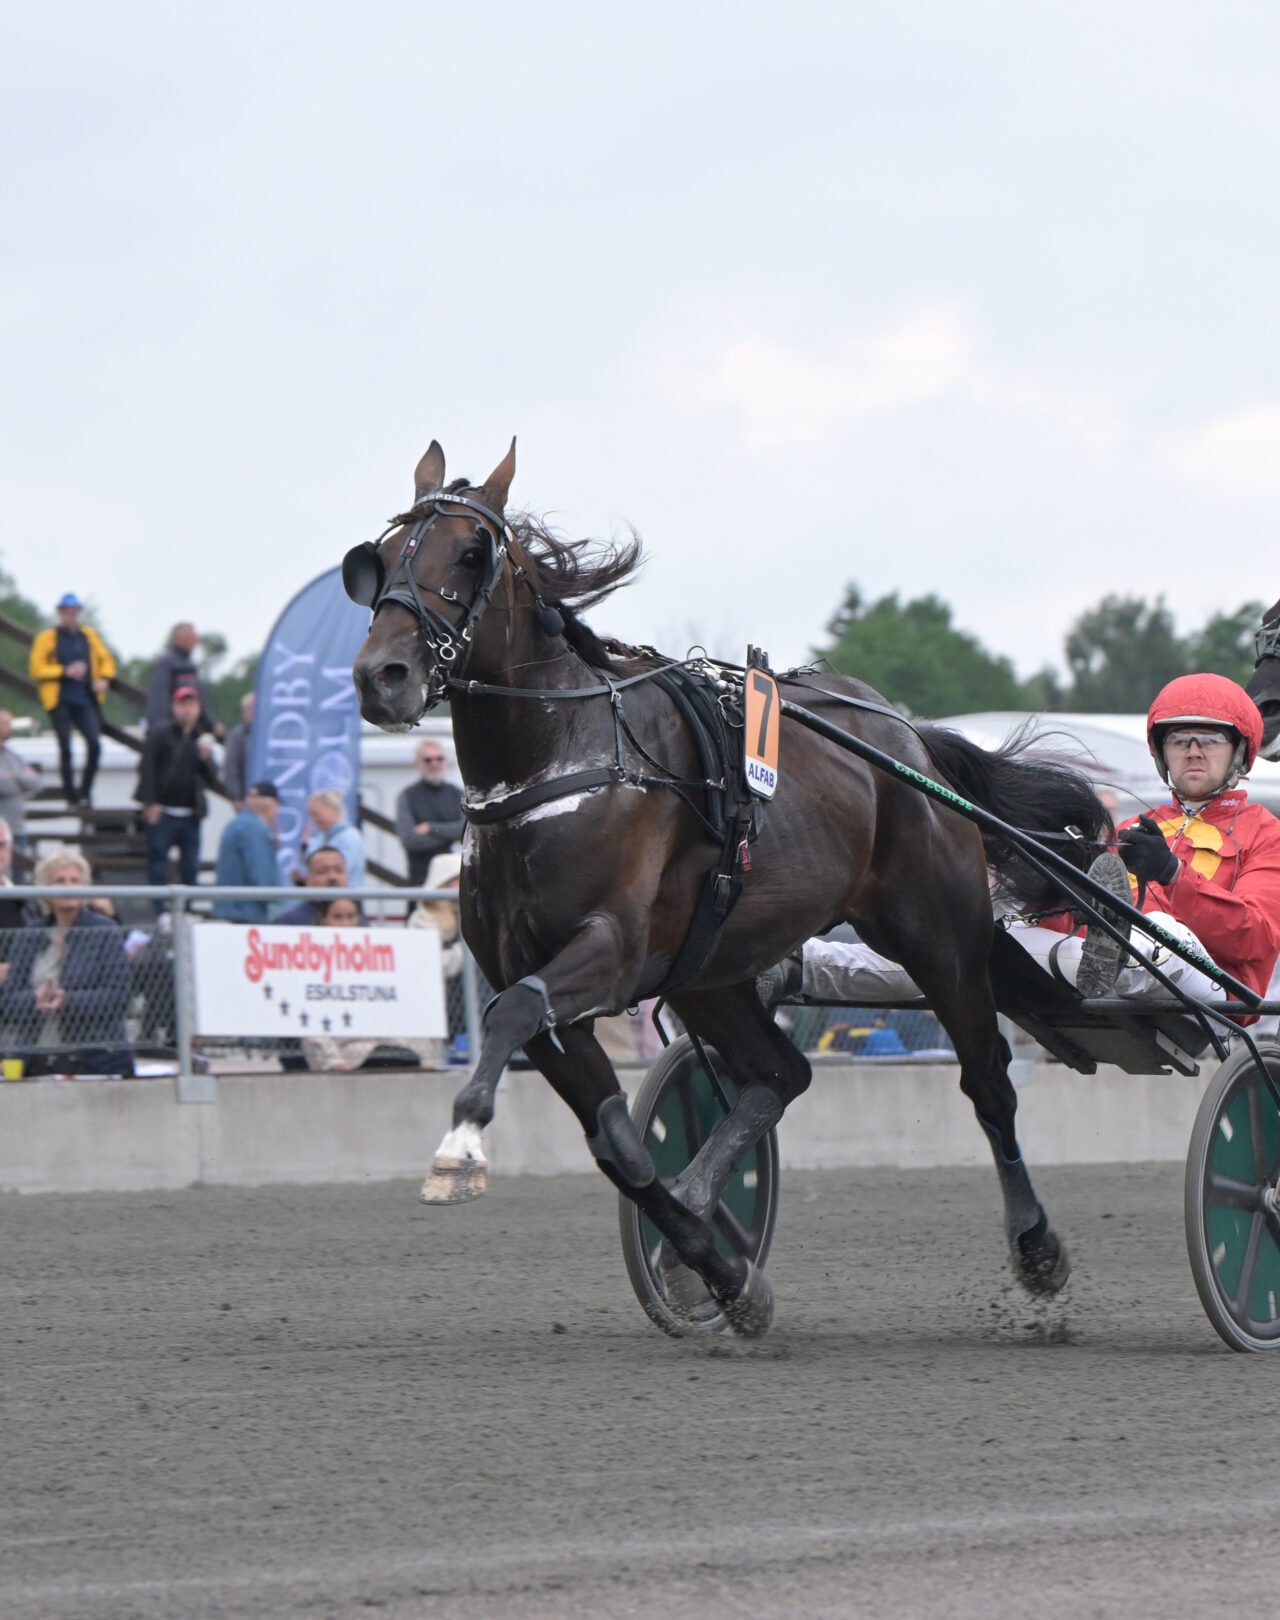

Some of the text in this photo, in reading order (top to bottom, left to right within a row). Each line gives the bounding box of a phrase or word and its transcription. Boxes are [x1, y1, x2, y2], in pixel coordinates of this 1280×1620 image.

[753, 672, 773, 758] 7
[748, 762, 775, 789] ALFAB
[244, 927, 396, 984] Sundbyholm
[305, 983, 398, 1002] ESKILSTUNA
